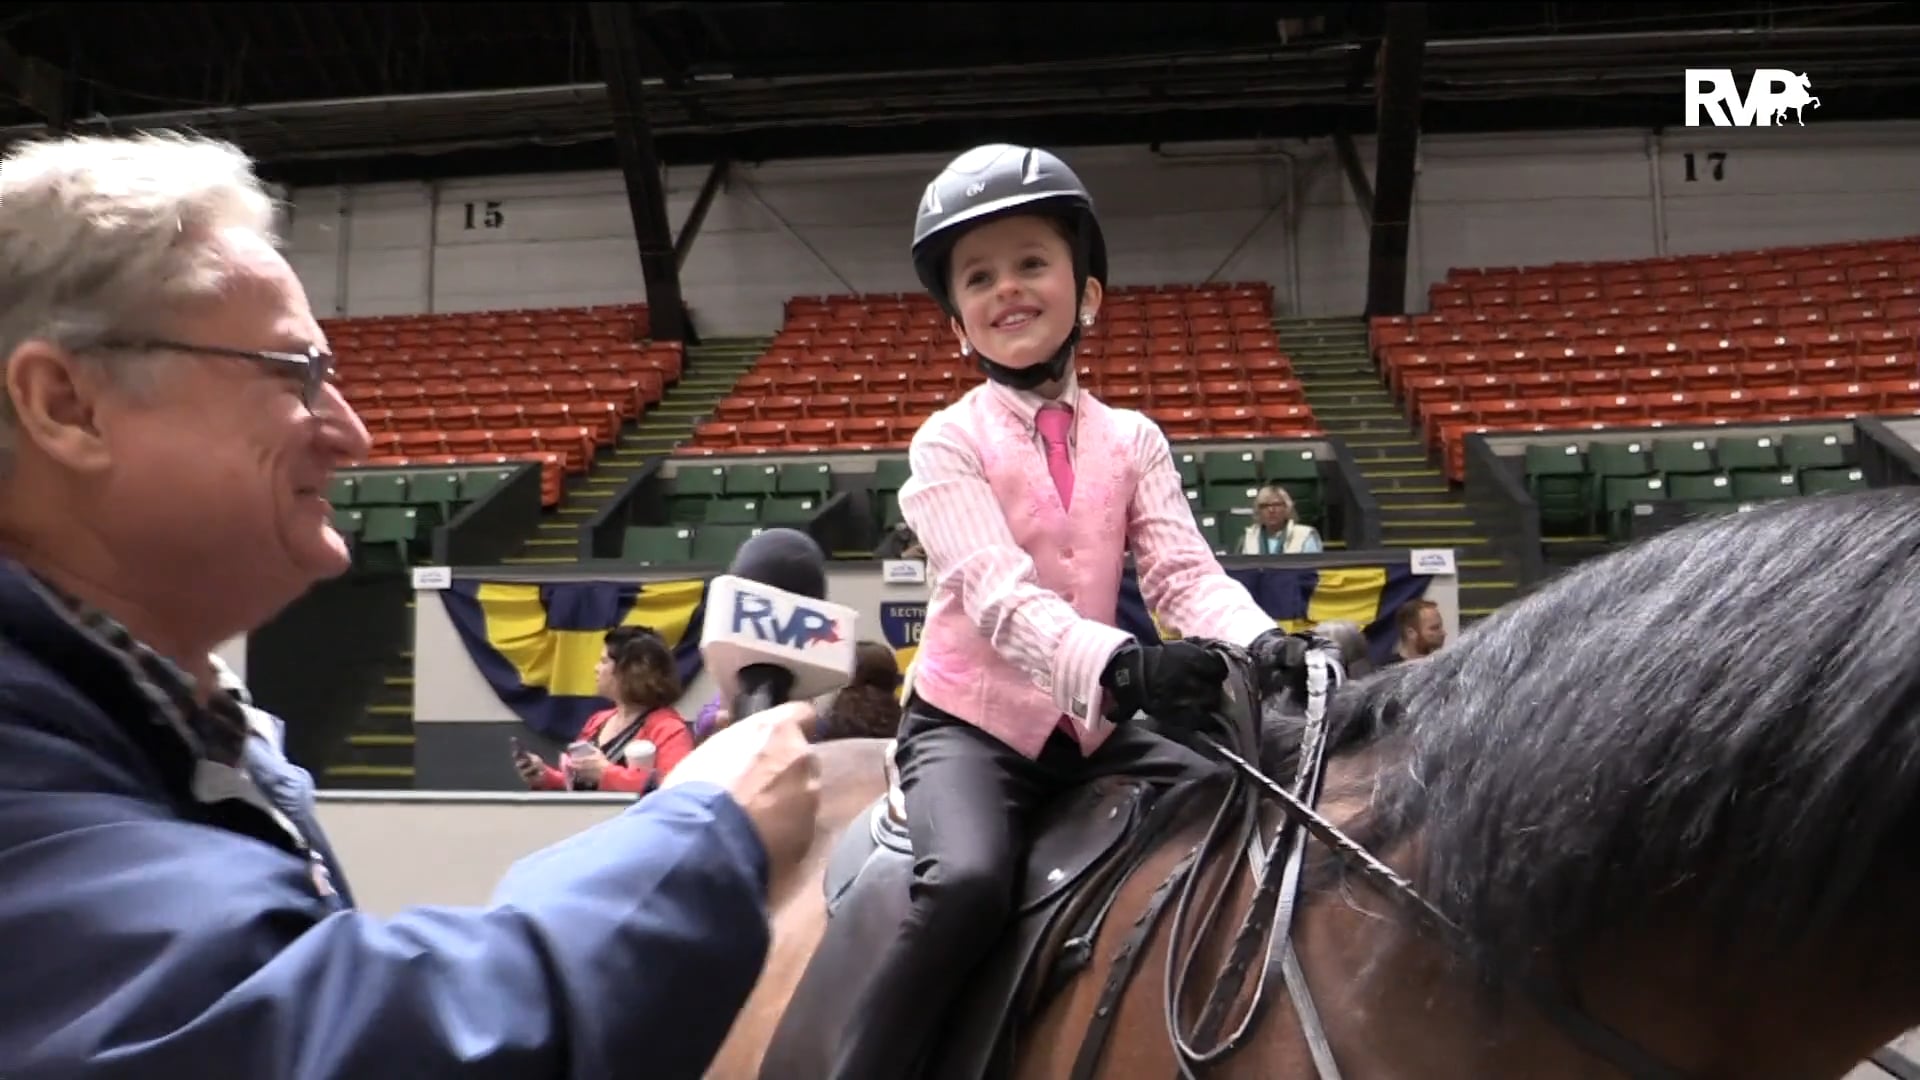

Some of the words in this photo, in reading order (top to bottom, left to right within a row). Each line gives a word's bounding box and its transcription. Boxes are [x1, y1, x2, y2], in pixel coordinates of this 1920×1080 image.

[1684, 152, 1727, 182] 17
[464, 201, 504, 230] 15
[732, 590, 835, 650] RVP
[889, 607, 927, 618] SECTI
[904, 622, 922, 643] 16
